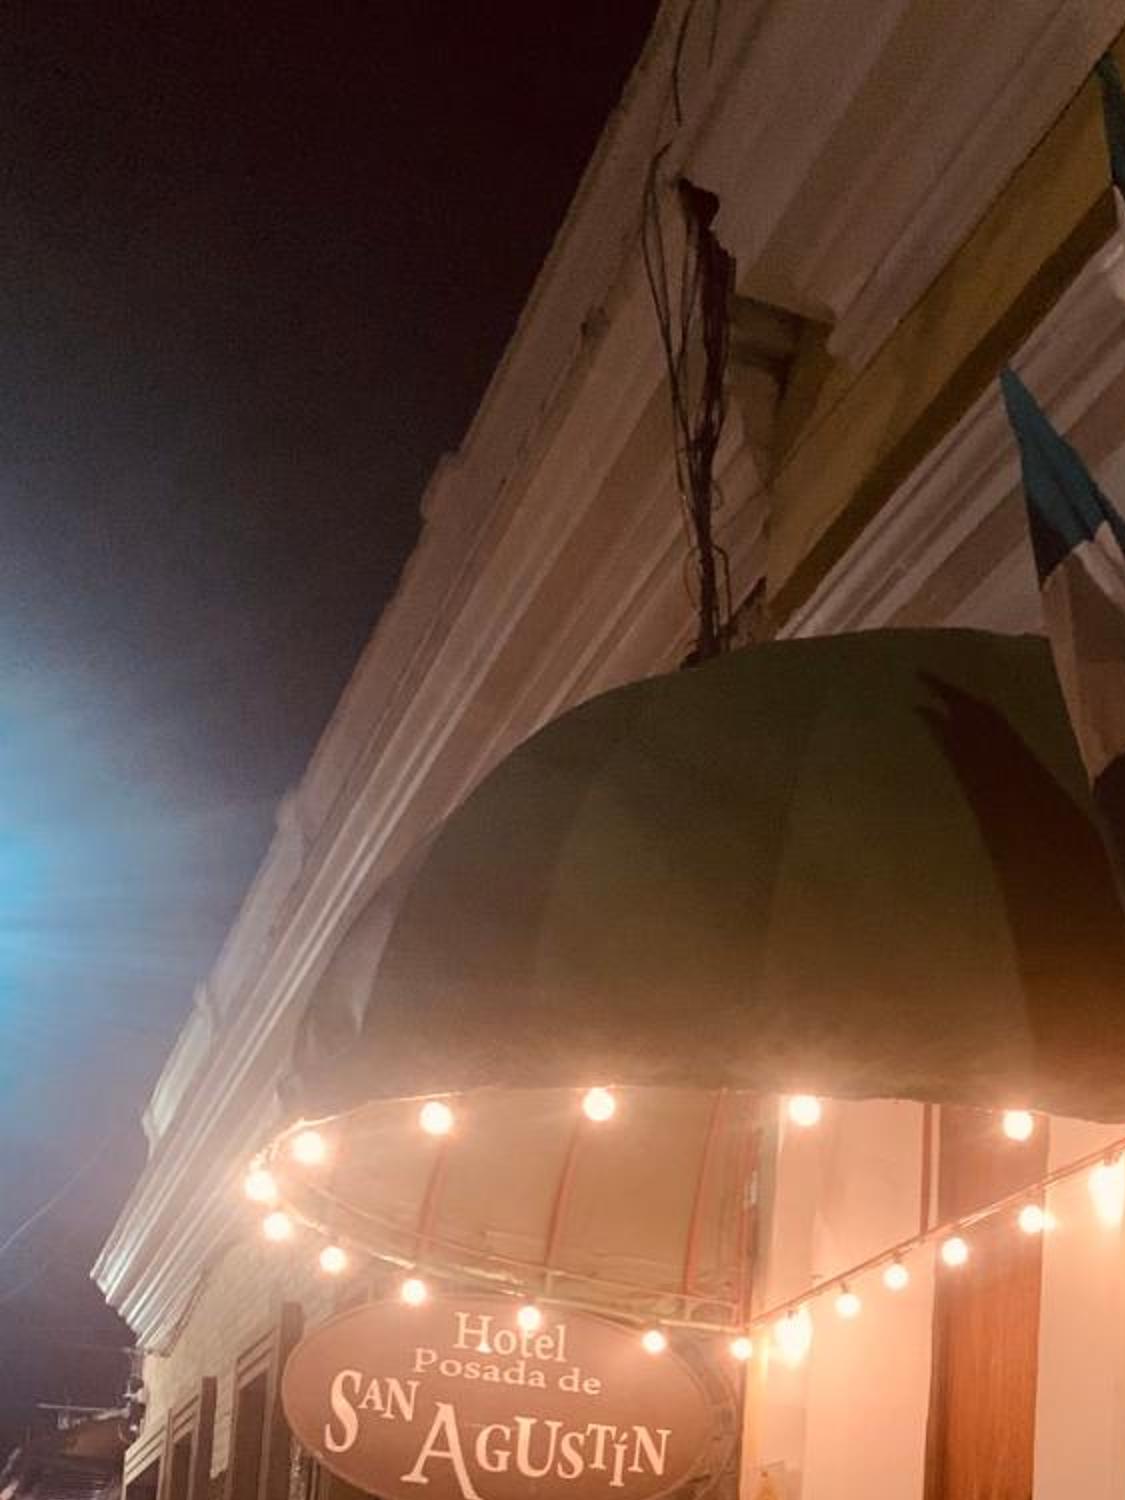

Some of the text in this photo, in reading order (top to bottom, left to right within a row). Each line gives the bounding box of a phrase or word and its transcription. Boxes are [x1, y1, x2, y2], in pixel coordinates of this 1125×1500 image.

[454, 1312, 567, 1363] Hotel
[413, 1348, 602, 1396] Posada de
[324, 1370, 420, 1453] SAN
